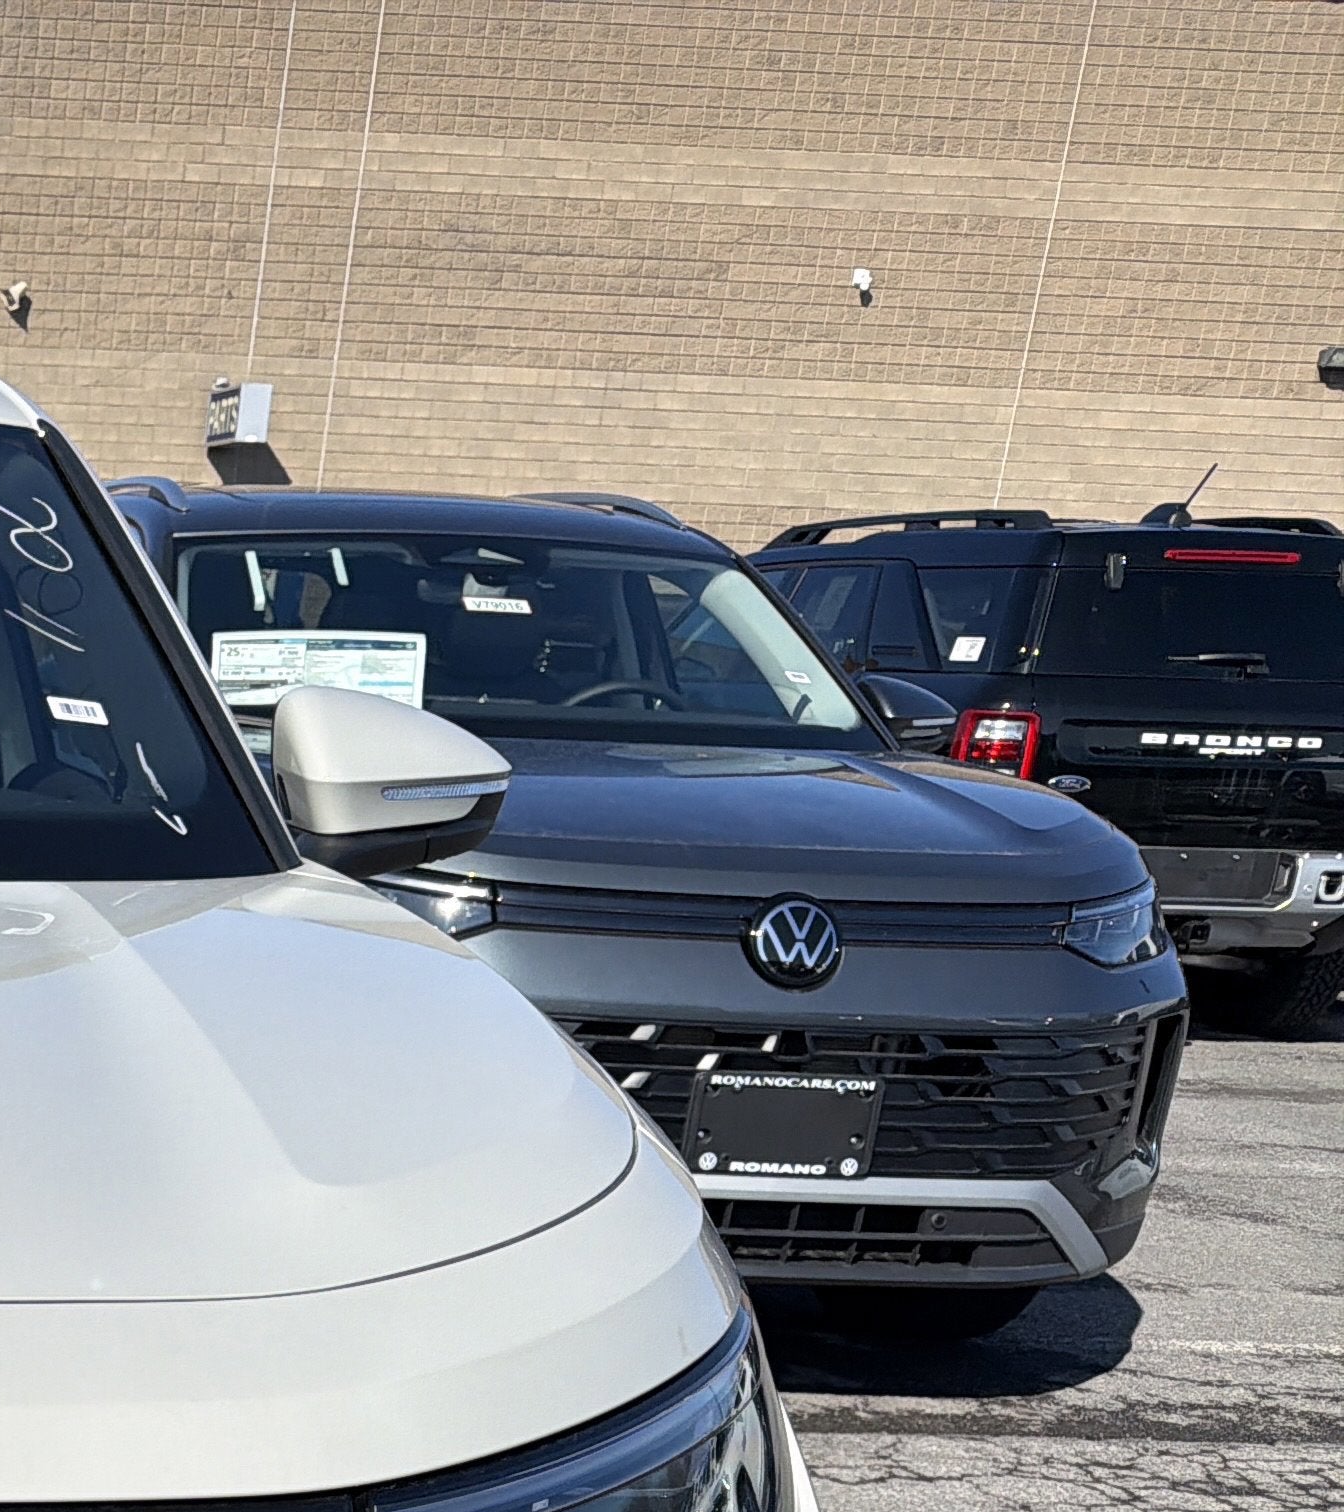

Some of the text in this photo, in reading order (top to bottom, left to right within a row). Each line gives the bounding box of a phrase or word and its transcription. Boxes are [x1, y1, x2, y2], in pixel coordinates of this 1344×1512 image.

[208, 395, 239, 436] PARTS
[1140, 732, 1323, 749] BRONCO
[710, 1074, 877, 1092] ROMANOCARS.COM
[728, 1161, 827, 1175] ROMANO
